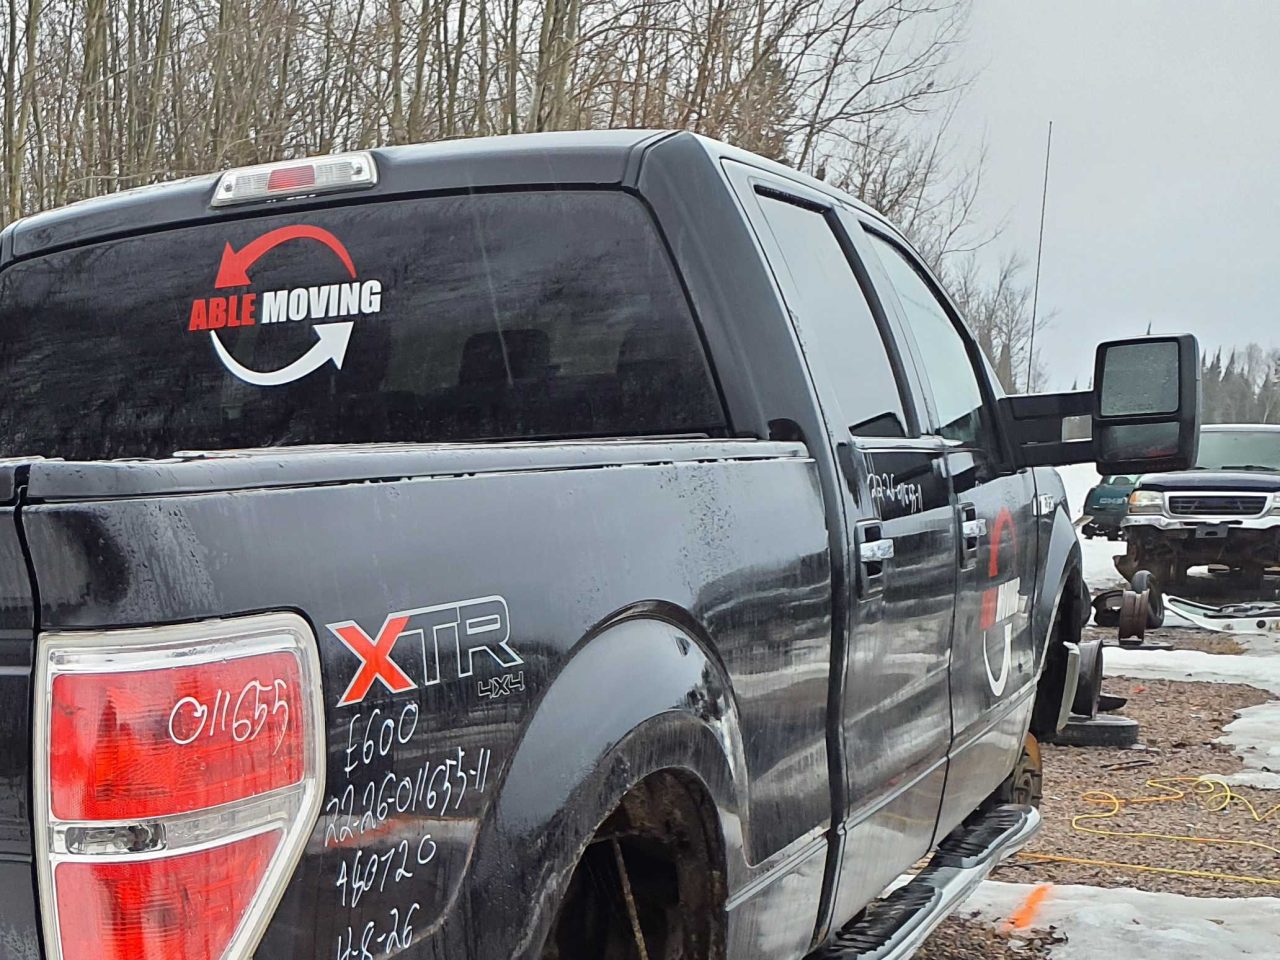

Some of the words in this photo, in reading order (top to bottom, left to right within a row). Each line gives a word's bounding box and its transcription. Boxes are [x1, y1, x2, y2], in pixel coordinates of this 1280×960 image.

[189, 294, 256, 331] ABLE
[261, 279, 381, 324] MOVING
[325, 595, 524, 707] XTR
[168, 678, 289, 756] 011655
[325, 746, 491, 848] 22-26-011655-11
